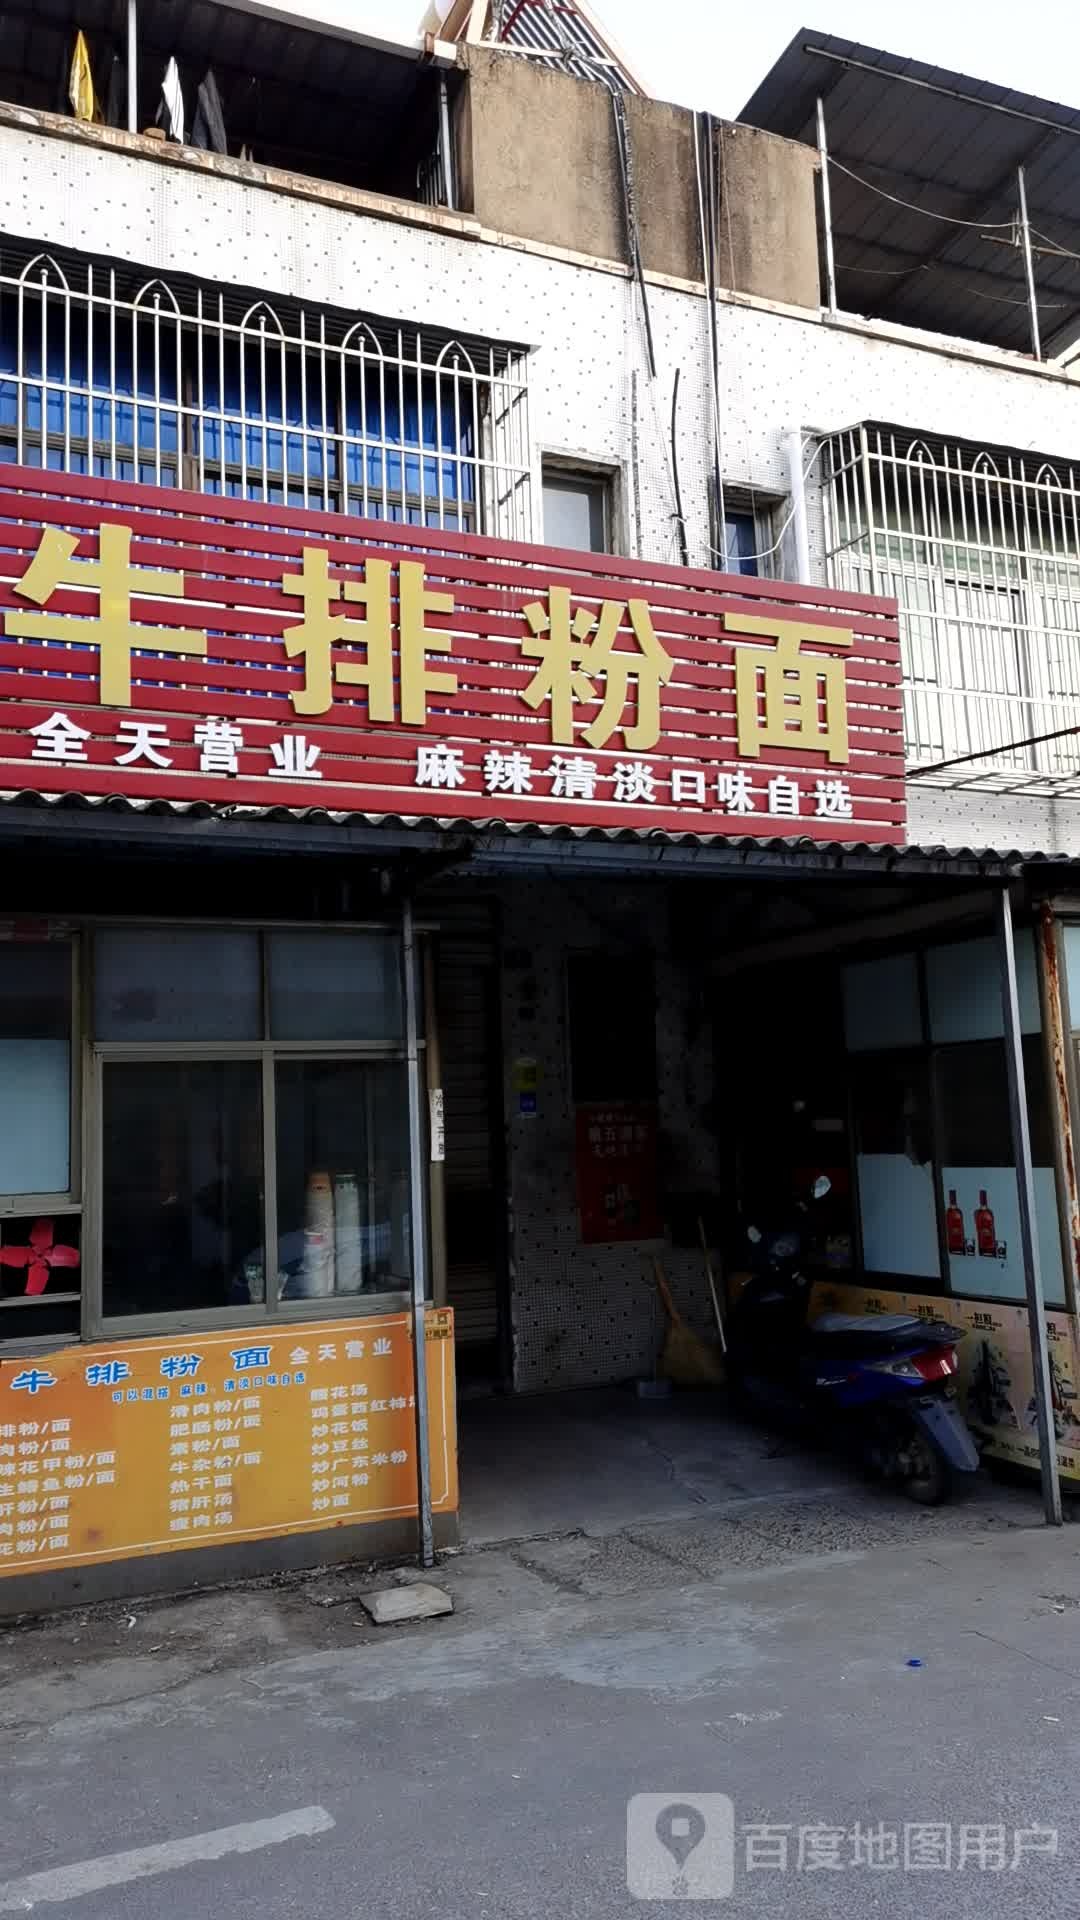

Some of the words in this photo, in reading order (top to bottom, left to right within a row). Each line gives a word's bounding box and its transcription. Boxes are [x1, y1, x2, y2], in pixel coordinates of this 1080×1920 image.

[5, 523, 853, 764] 牛排粉面
[29, 712, 322, 778] 全天营业
[415, 744, 853, 817] 麻辣清淡口味自选
[11, 1346, 272, 1394] 牛排粉面
[289, 1338, 392, 1364] 全天营业
[112, 1386, 170, 1403] 可以混搭
[311, 1450, 408, 1473] 炒广东米粉
[169, 1474, 232, 1494] 热干面
